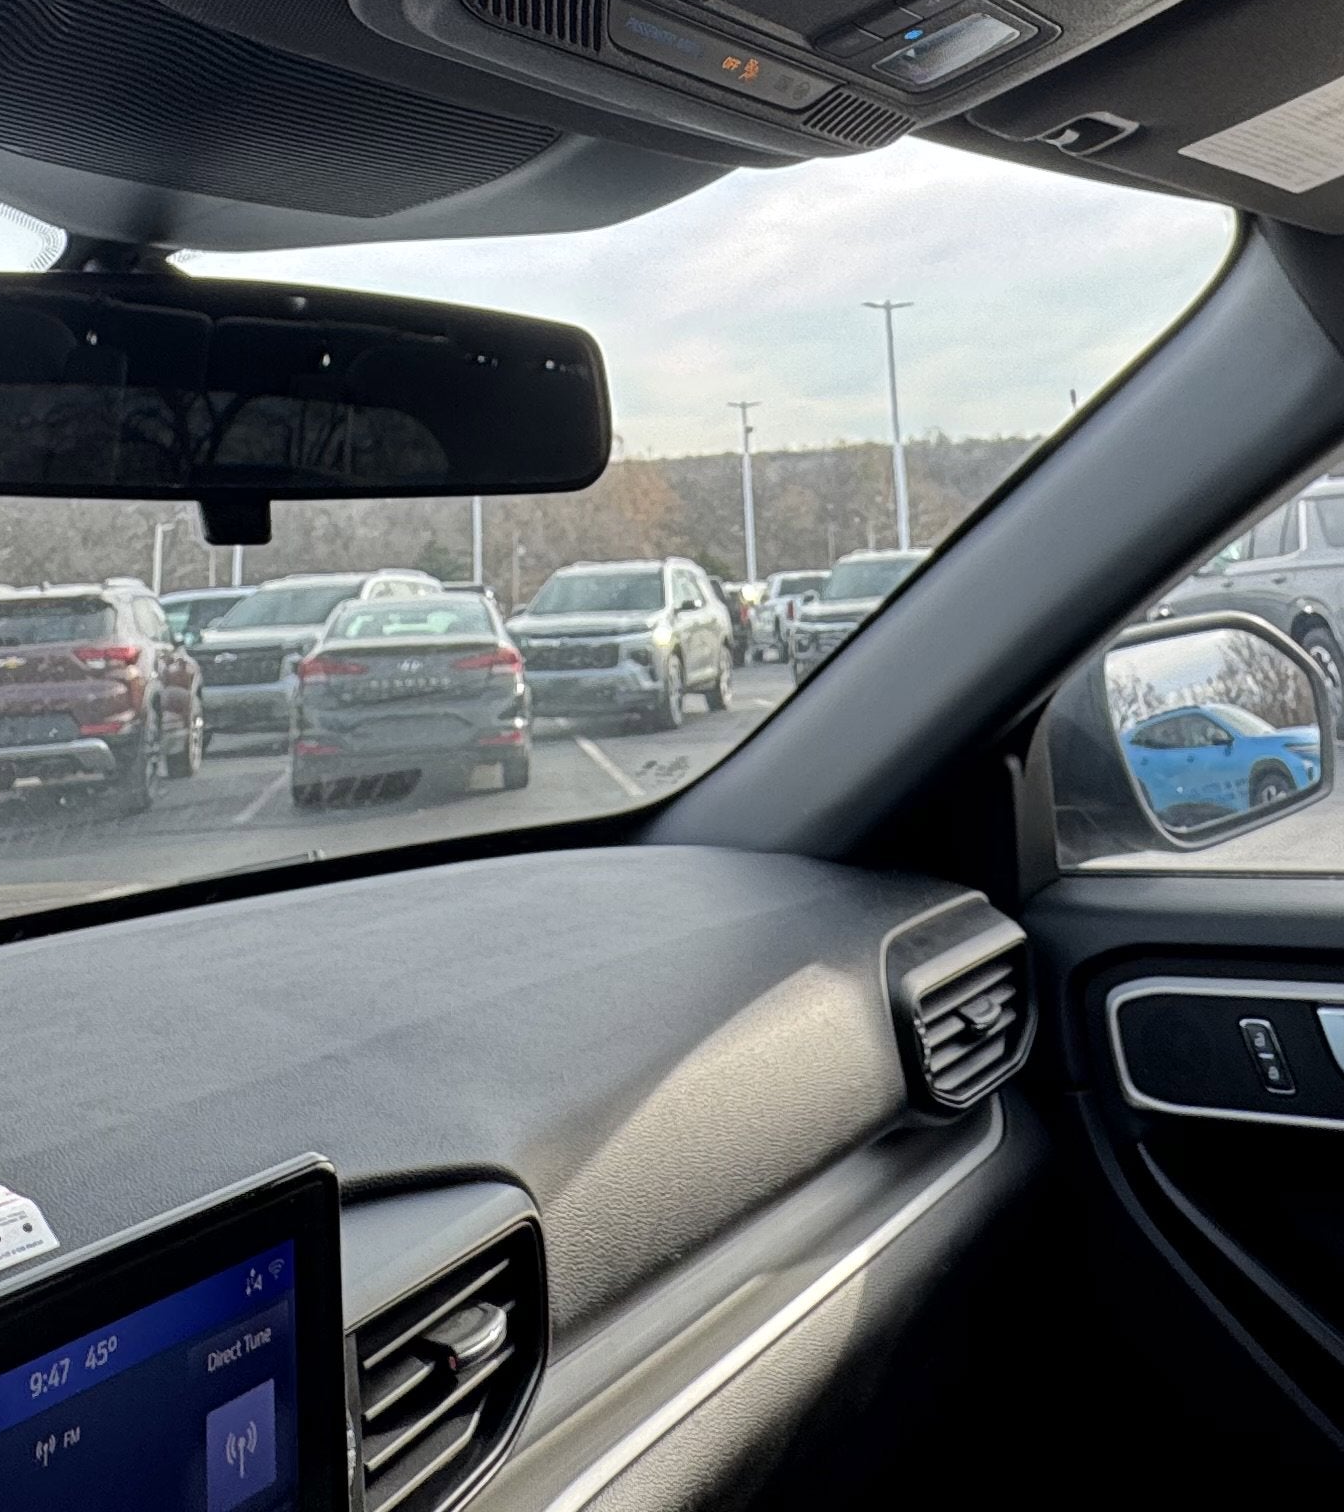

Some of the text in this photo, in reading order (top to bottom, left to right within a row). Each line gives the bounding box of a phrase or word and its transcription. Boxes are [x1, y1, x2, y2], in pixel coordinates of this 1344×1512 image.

[207, 1325, 272, 1372] Direct Tune
[29, 1358, 70, 1398] 9:47
[64, 1426, 80, 1449] FM
